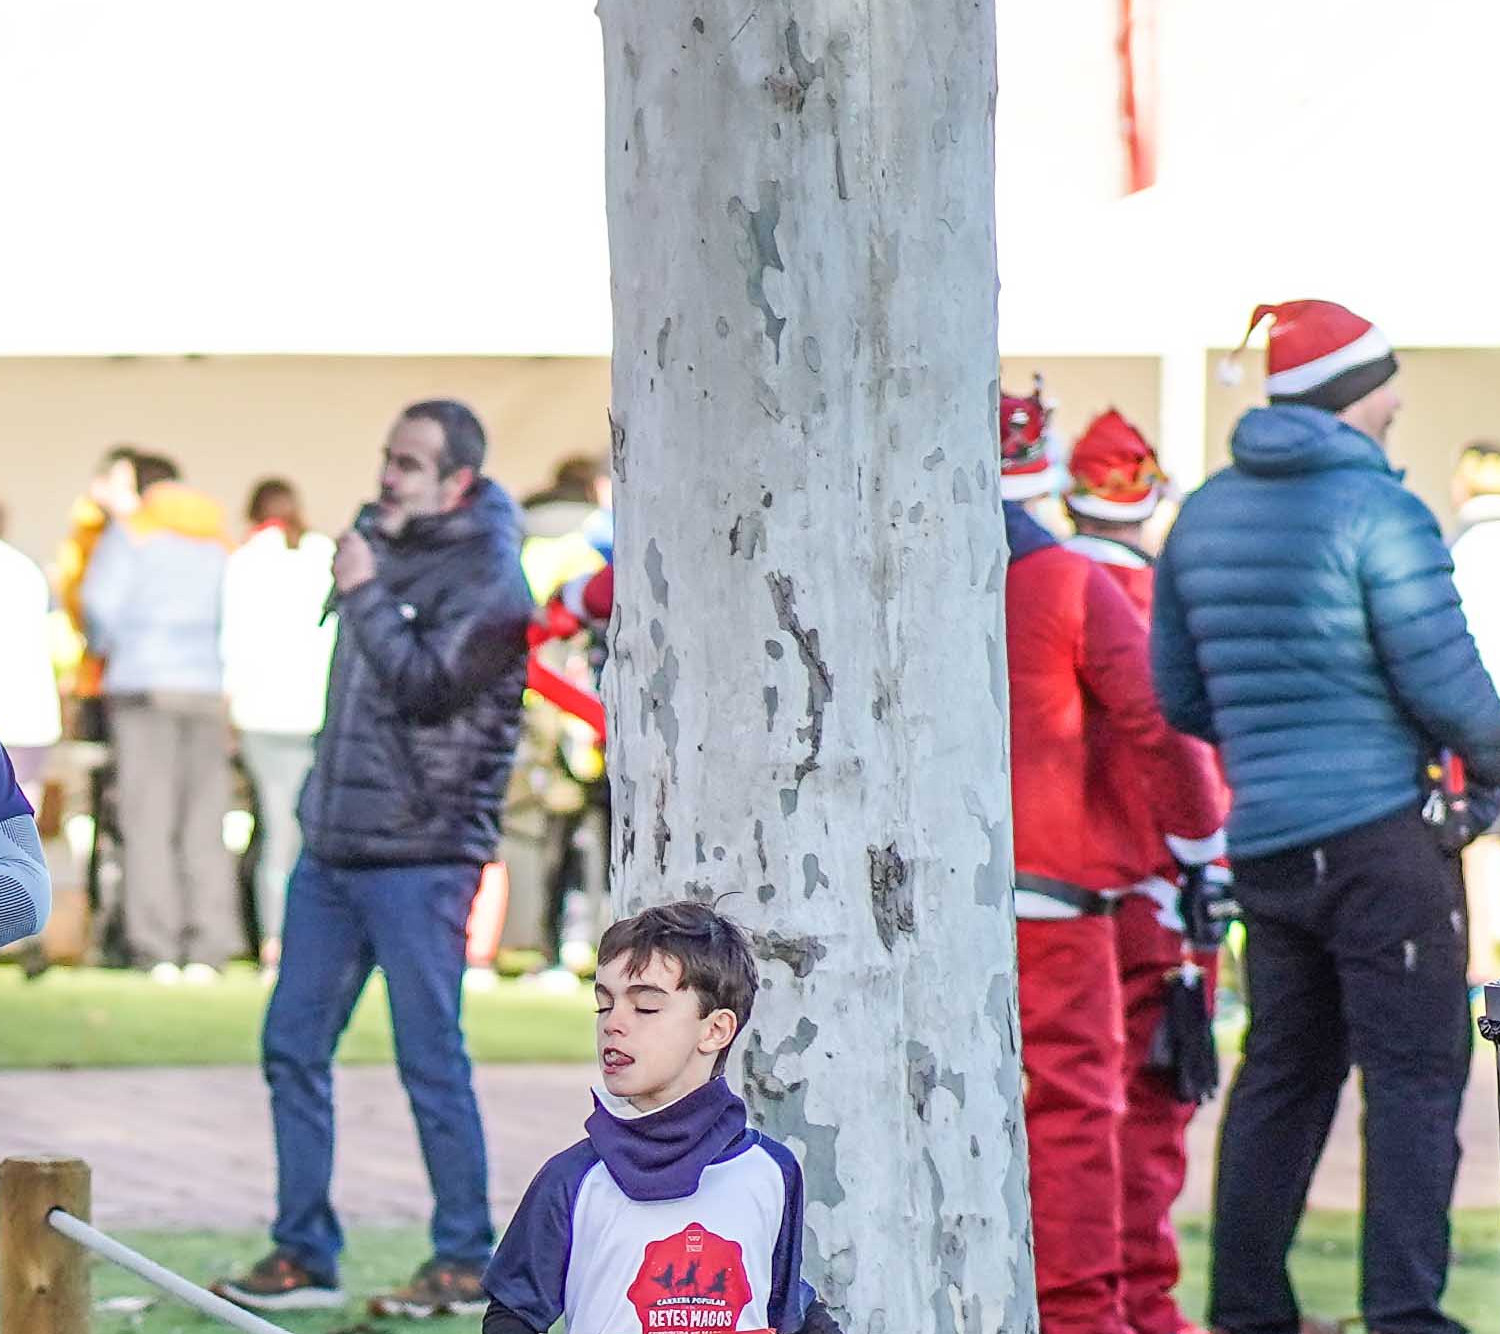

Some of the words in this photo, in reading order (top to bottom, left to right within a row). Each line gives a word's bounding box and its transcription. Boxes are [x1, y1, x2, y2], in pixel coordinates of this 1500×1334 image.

[657, 1297, 690, 1306] CARRERA
[691, 1297, 726, 1306] POPULAR
[649, 1309, 688, 1327] REYES
[689, 1309, 733, 1328] MAGOS
